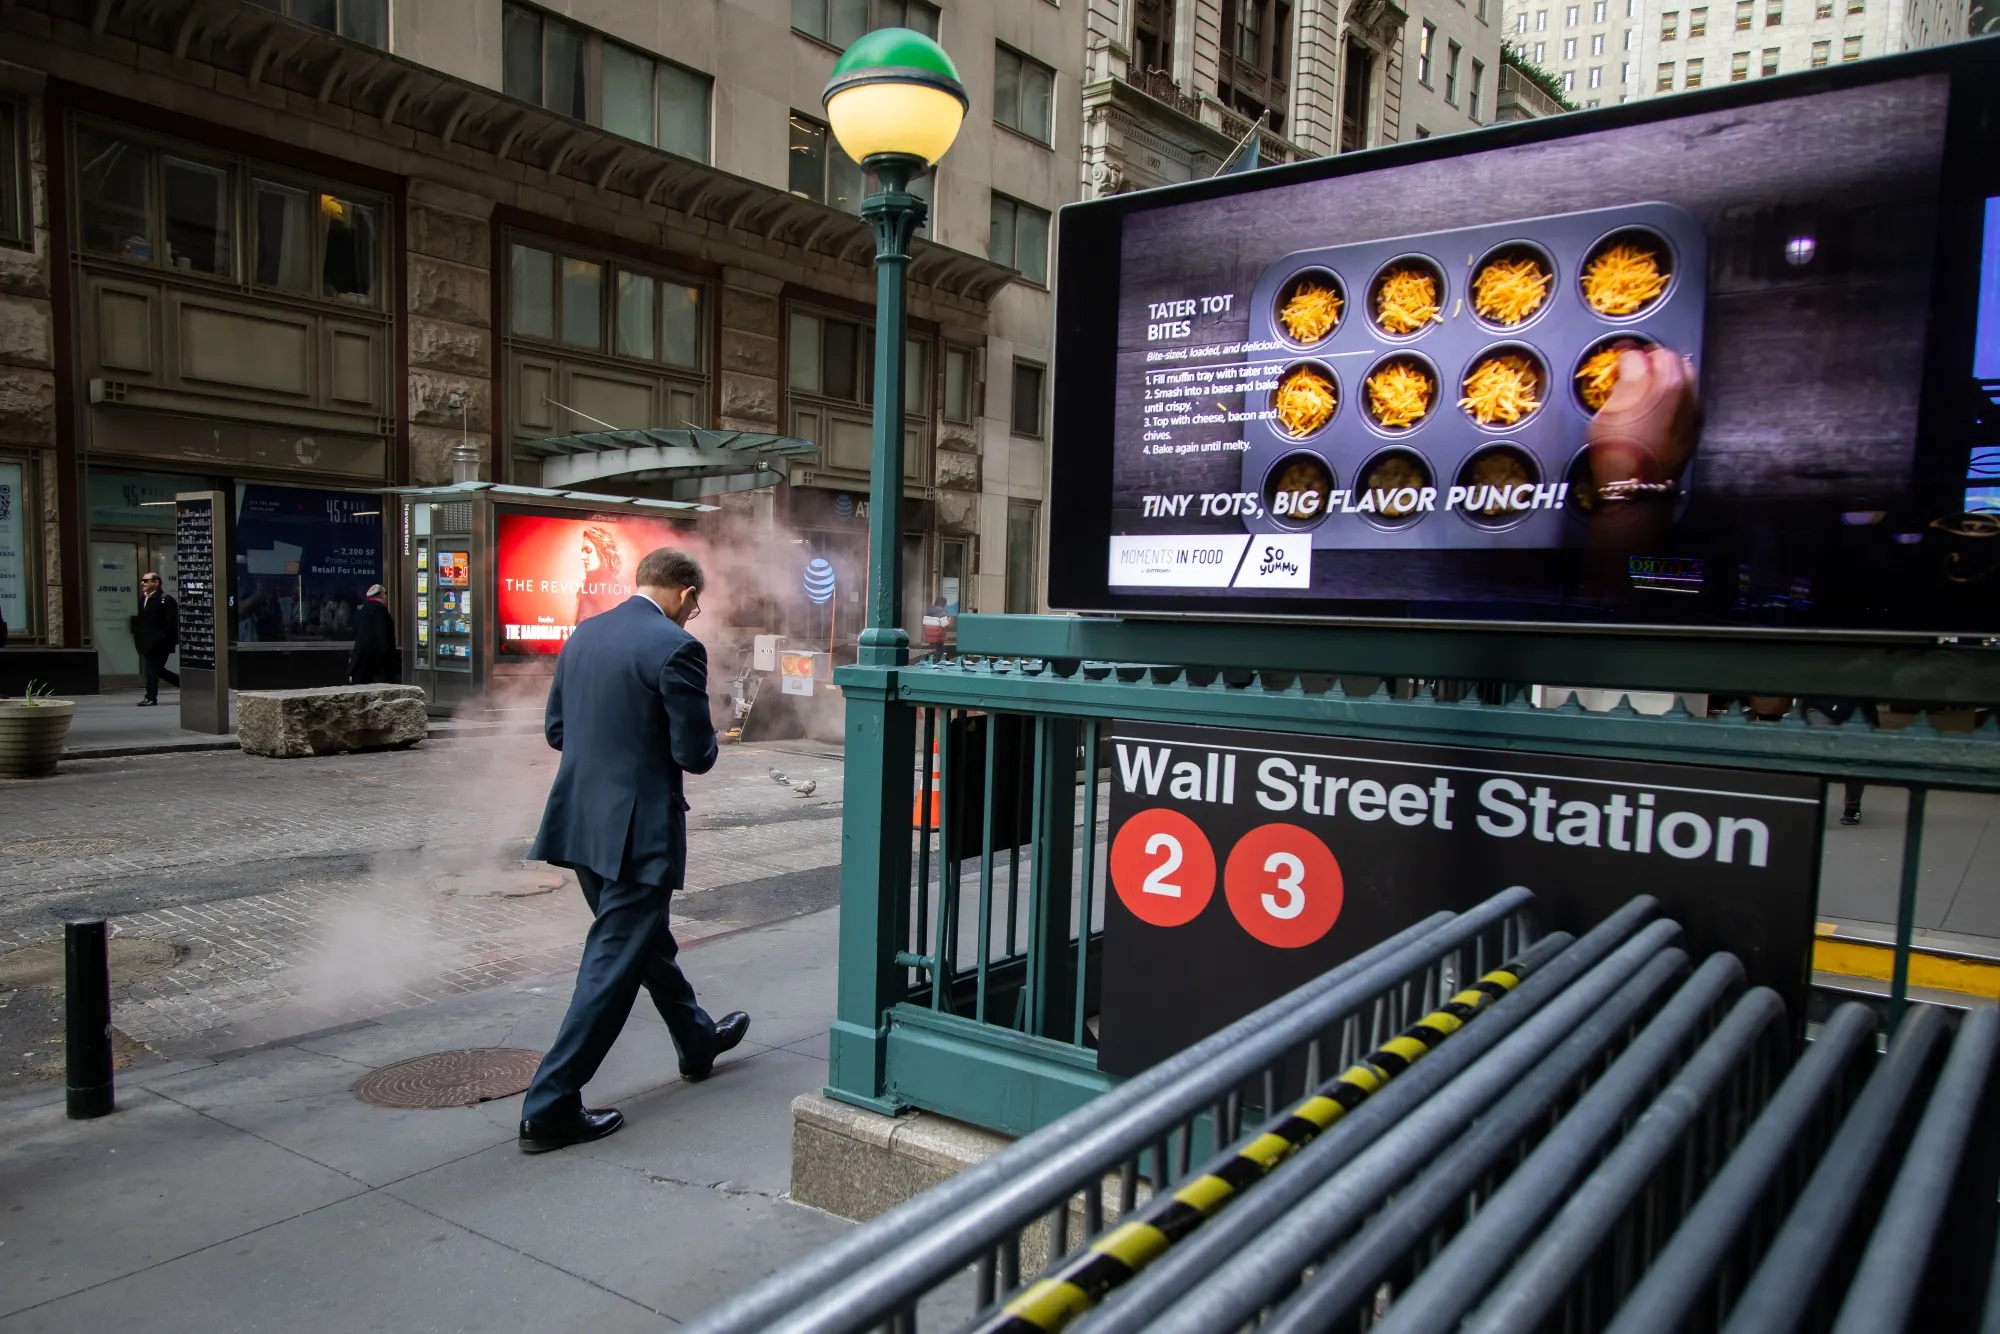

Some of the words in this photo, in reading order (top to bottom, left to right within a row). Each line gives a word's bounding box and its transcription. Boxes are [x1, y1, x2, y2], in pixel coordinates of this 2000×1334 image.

[1148, 299, 1197, 320] TATER
[1200, 294, 1234, 314] TOT
[1147, 320, 1191, 341] BITES
[1146, 349, 1189, 362] Bite-sized,
[1190, 345, 1221, 358] loaded,
[1222, 343, 1240, 354] and
[1153, 374, 1165, 385] Fill
[1167, 372, 1195, 384] muffin
[1196, 371, 1214, 383] tray
[1216, 368, 1237, 380] with
[1239, 366, 1262, 377] tater
[1144, 390, 1152, 400] 2.
[1154, 387, 1183, 400] Smash
[1184, 385, 1202, 397] into
[1203, 387, 1210, 395] a
[1211, 383, 1234, 395] base
[1235, 381, 1254, 393] and
[1255, 379, 1279, 391] bake
[1144, 402, 1164, 414] until
[1165, 401, 1192, 414] crispy.
[1143, 417, 1152, 428] 3.
[1153, 416, 1169, 429] Top
[1170, 414, 1190, 426] with
[1192, 413, 1226, 425] cheese,
[1227, 411, 1257, 423] bacon
[1258, 408, 1278, 420] and
[1143, 430, 1172, 442] chives.
[1142, 445, 1151, 455] 4.
[1152, 444, 1174, 455] Bake
[1175, 442, 1199, 456] again
[1201, 441, 1222, 453] until
[1222, 440, 1251, 453] melty.
[1141, 494, 1194, 517] TINY
[1199, 491, 1265, 521] TOTS,
[1272, 489, 1320, 515] BIG
[1325, 486, 1438, 515] FLAVOR
[1445, 482, 1567, 512] PUNCH!
[326, 499, 341, 524] 45
[325, 556, 348, 565] Prime
[341, 547, 364, 557] 2,200
[1120, 549, 1174, 564] MOMENTS
[1176, 549, 1189, 564] IN
[1191, 549, 1224, 564] FOOD
[312, 565, 336, 574] Retail
[337, 566, 351, 574] For
[352, 567, 376, 575] Lease
[459, 566, 468, 578] 30
[505, 578, 534, 593] THE
[541, 579, 632, 596] REVOLUTION
[506, 624, 520, 640] THE
[1115, 743, 1236, 806] Wall
[1256, 755, 1455, 831] Street
[1477, 778, 1770, 868] Station
[1142, 833, 1184, 898] 2
[1260, 851, 1307, 920] 3
